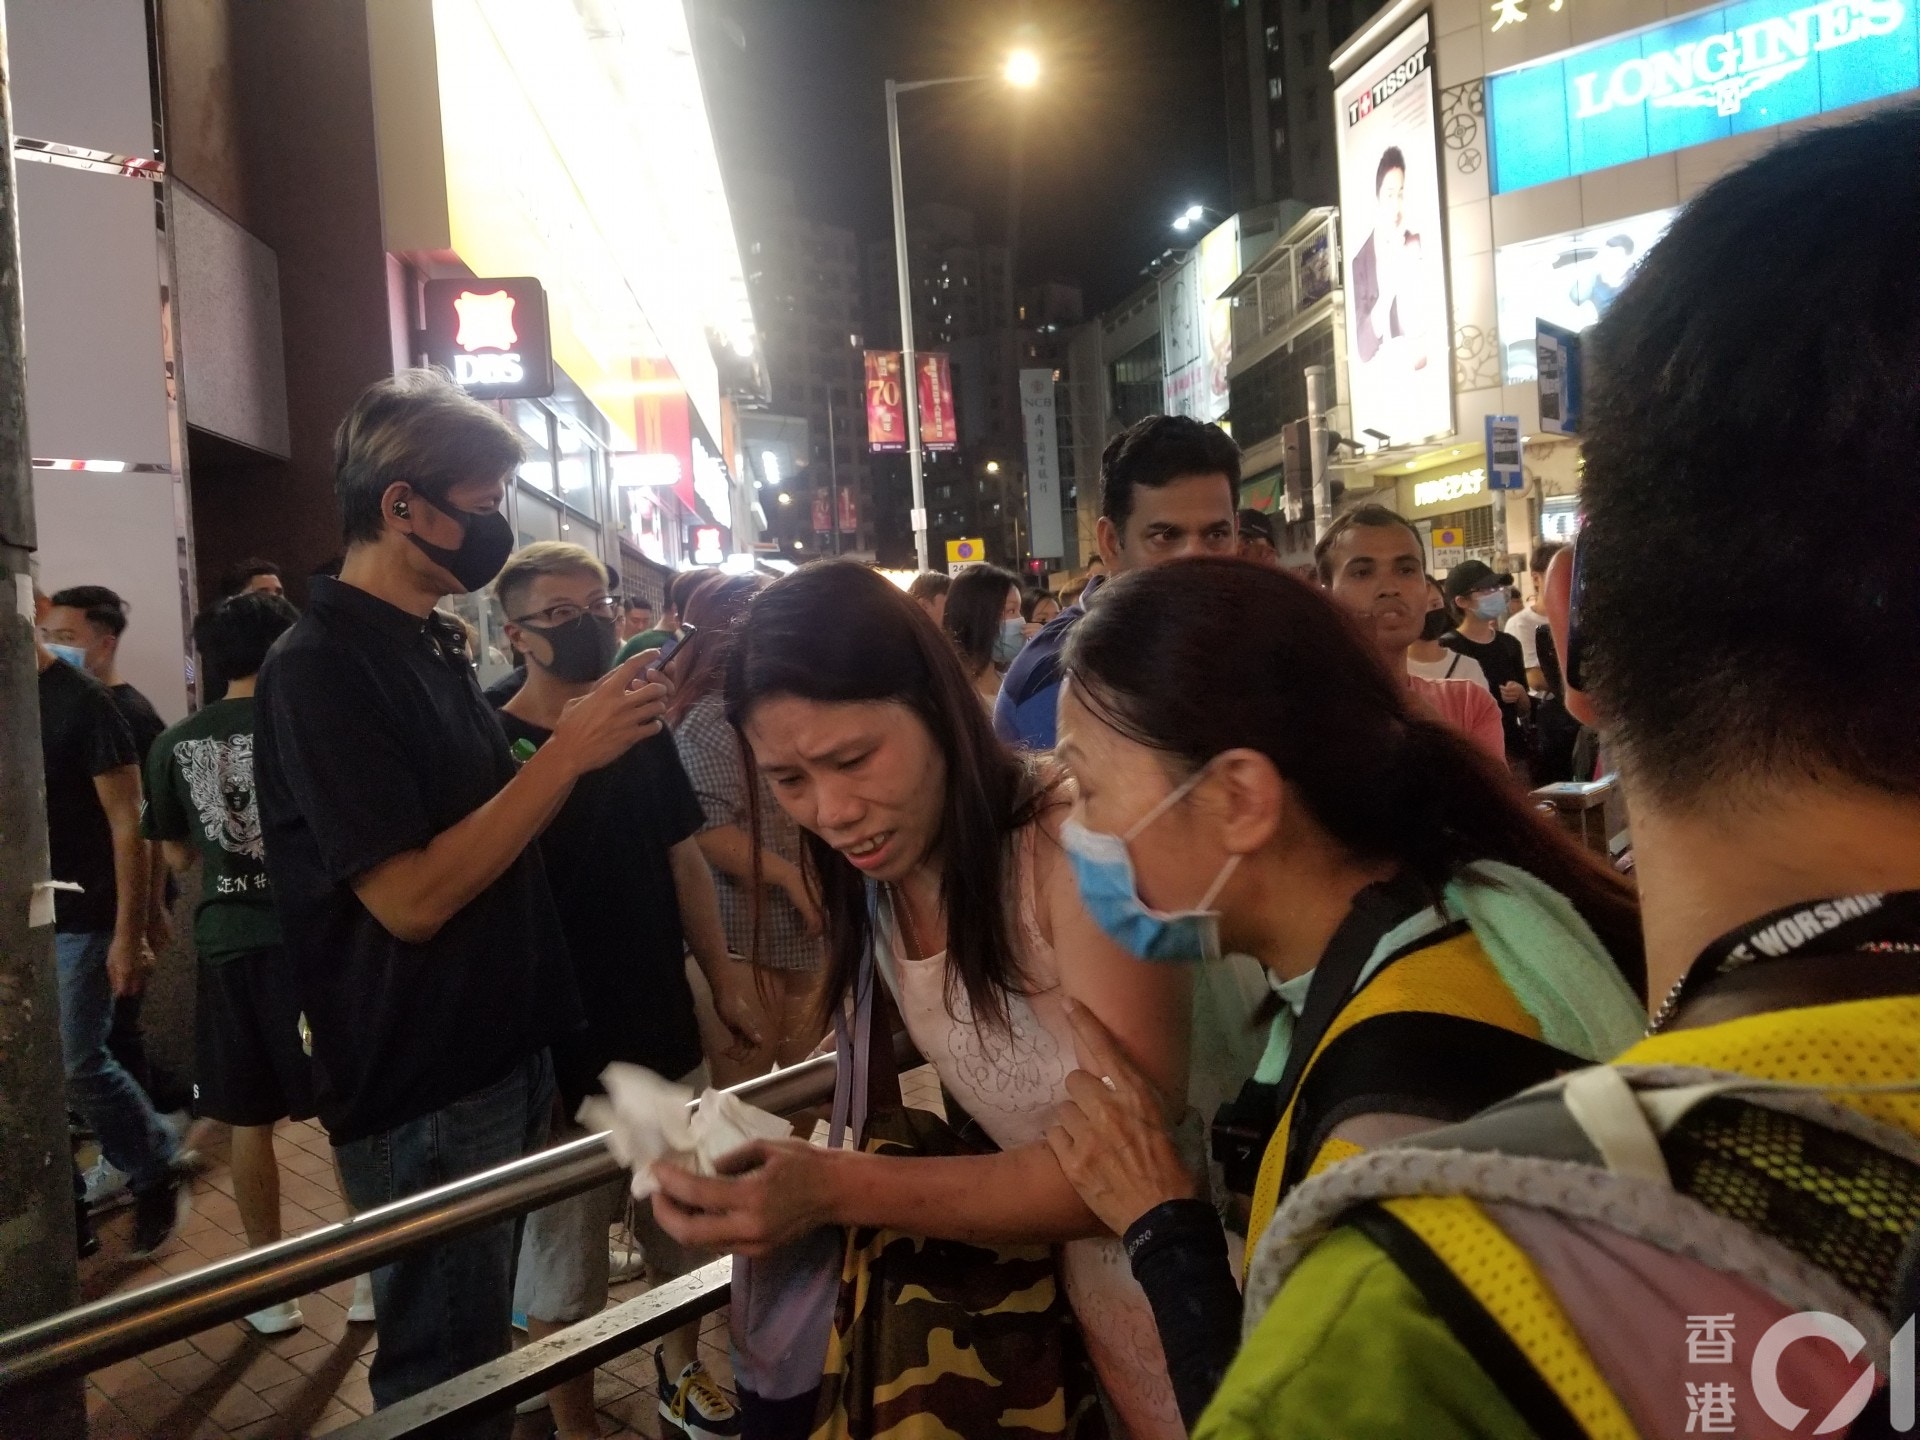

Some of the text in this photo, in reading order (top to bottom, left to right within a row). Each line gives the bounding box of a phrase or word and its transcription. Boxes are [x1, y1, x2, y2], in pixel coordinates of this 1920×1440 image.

[1490, 0, 1563, 32] 太
[1574, 0, 1905, 118] LONGINES
[1372, 46, 1428, 106] TISSOT
[454, 353, 523, 385] DBS
[869, 380, 900, 407] 70
[1025, 398, 1052, 408] NCB
